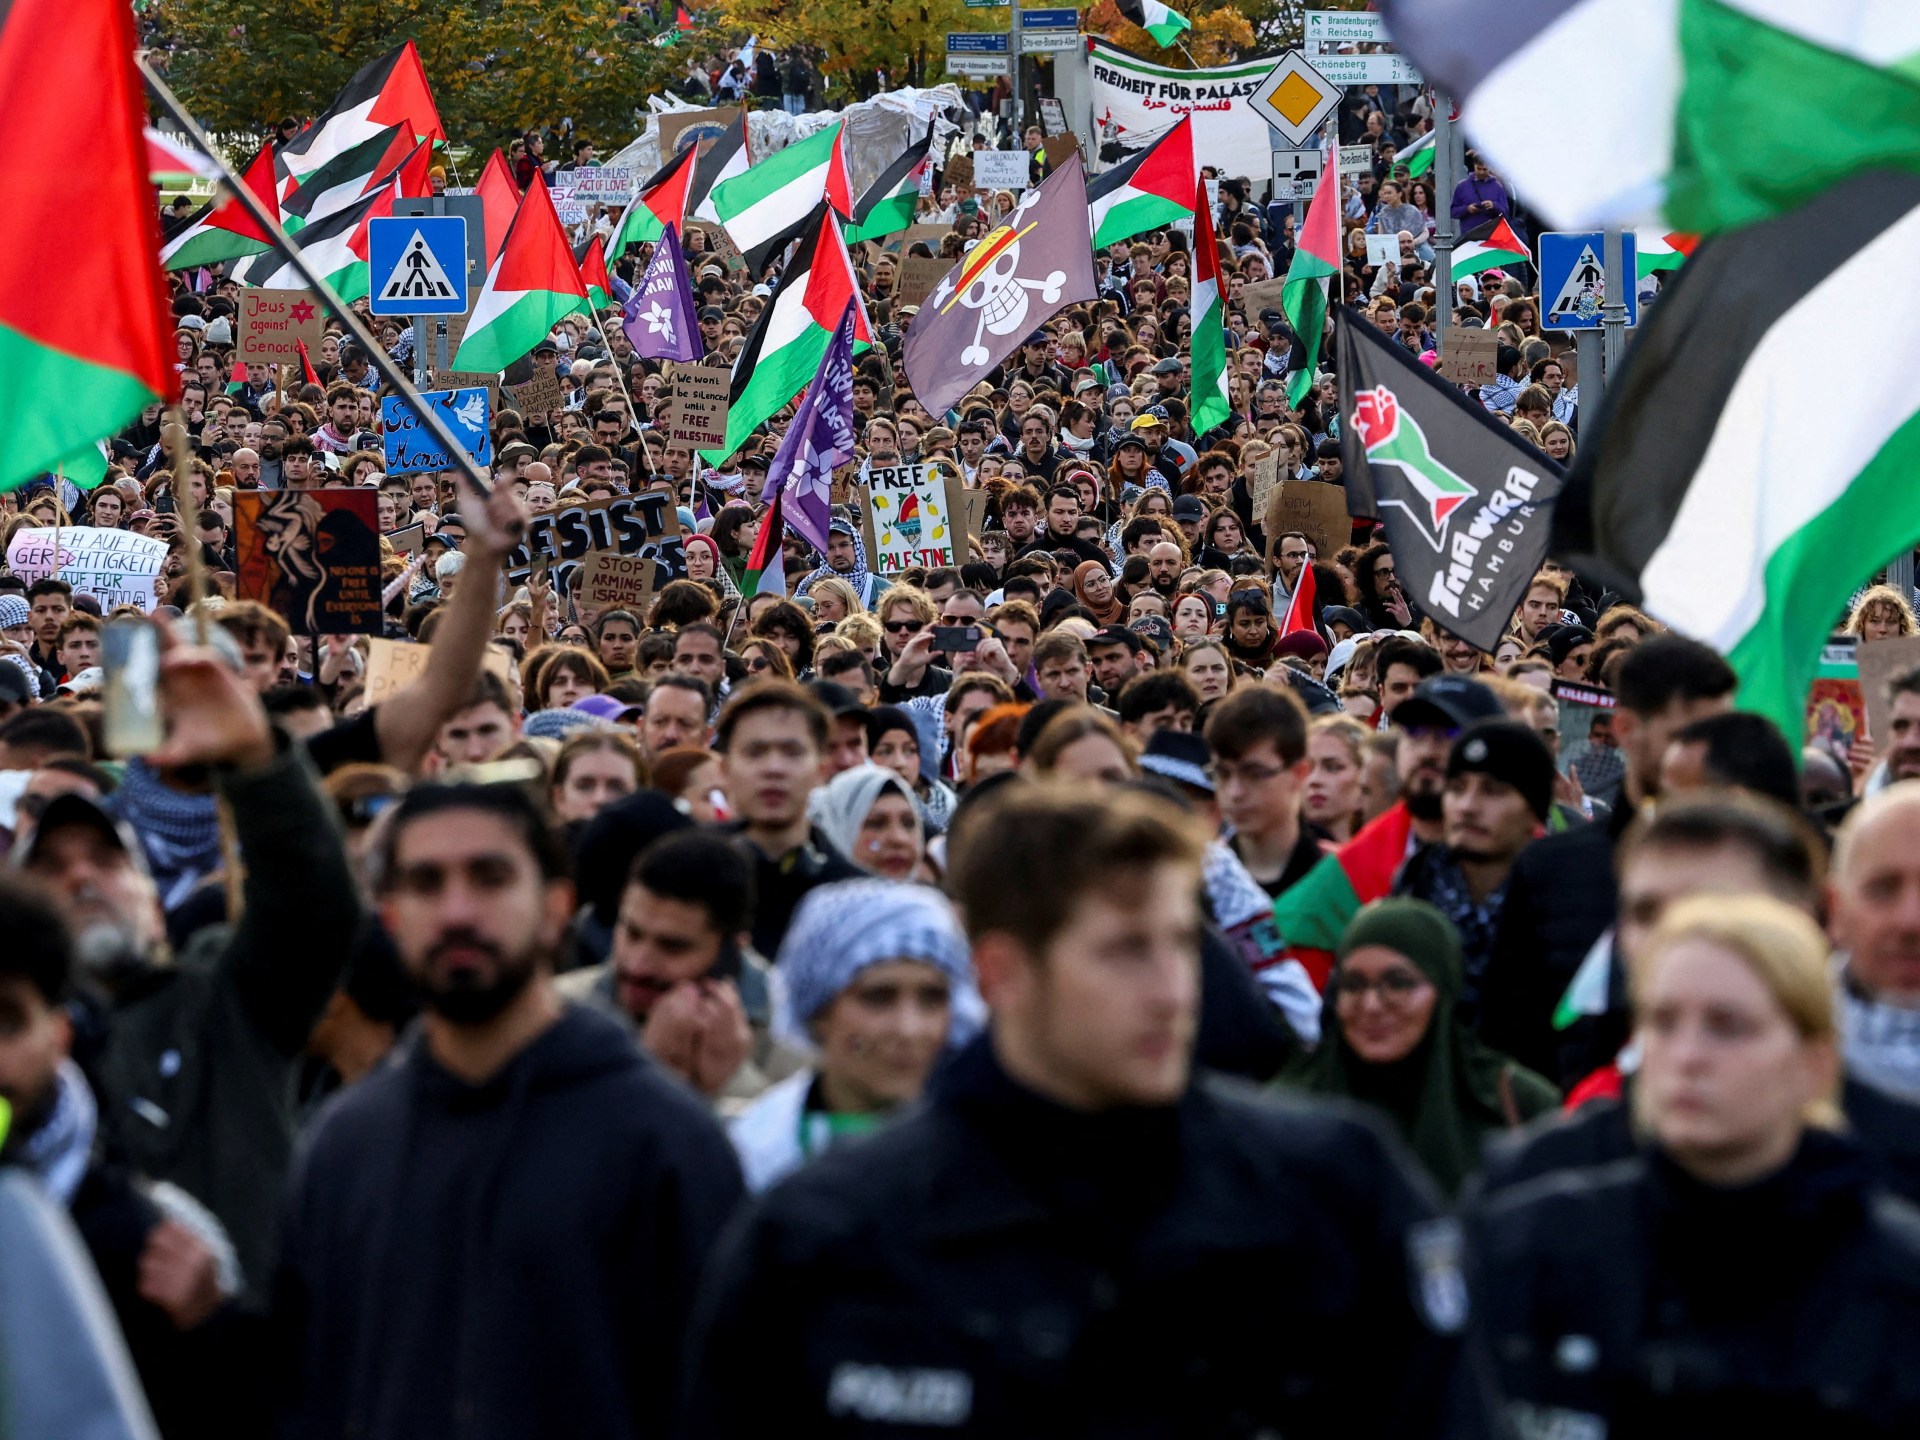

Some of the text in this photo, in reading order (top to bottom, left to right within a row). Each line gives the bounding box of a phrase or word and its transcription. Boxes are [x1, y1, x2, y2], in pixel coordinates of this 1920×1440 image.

[1328, 16, 1379, 27] Brandenburger
[1328, 28, 1373, 38] Reichstag
[1310, 60, 1366, 70] Schöneberg
[1094, 65, 1155, 96] FREIHEIT
[1159, 82, 1191, 100] FÜR
[1143, 96, 1167, 110] حرة
[574, 166, 595, 179] GRIEF
[612, 167, 629, 179] LAST
[981, 176, 1024, 184] INNOCENT!
[578, 179, 594, 191] ACT
[596, 180, 604, 191] OF
[605, 180, 627, 191] LOVE
[247, 295, 285, 317] Jews
[250, 319, 290, 334] against
[531, 366, 550, 383] ONE
[1447, 360, 1495, 377] YEARS
[677, 372, 720, 385] We won't
[677, 387, 689, 398] be
[527, 399, 560, 413] ANOTHER
[684, 402, 716, 412] until a
[682, 414, 710, 428] FREE
[673, 429, 724, 445] PALESTINE
[868, 466, 925, 491] FREE
[89, 533, 125, 551] AUF
[128, 537, 166, 560] FÜR
[15, 547, 158, 574] GERECHTIGKEIT
[878, 547, 954, 573] PALESTINE
[1466, 504, 1536, 611] HAMBUR
[598, 556, 644, 576] STOP
[60, 572, 87, 586] AUF
[95, 571, 123, 589] FÜR
[591, 573, 643, 592] ARMING
[339, 590, 371, 600] UNTIL
[592, 589, 642, 606] ISRAEL
[325, 601, 381, 614] EVERYONE
[1557, 685, 1616, 708] KILLED BY
